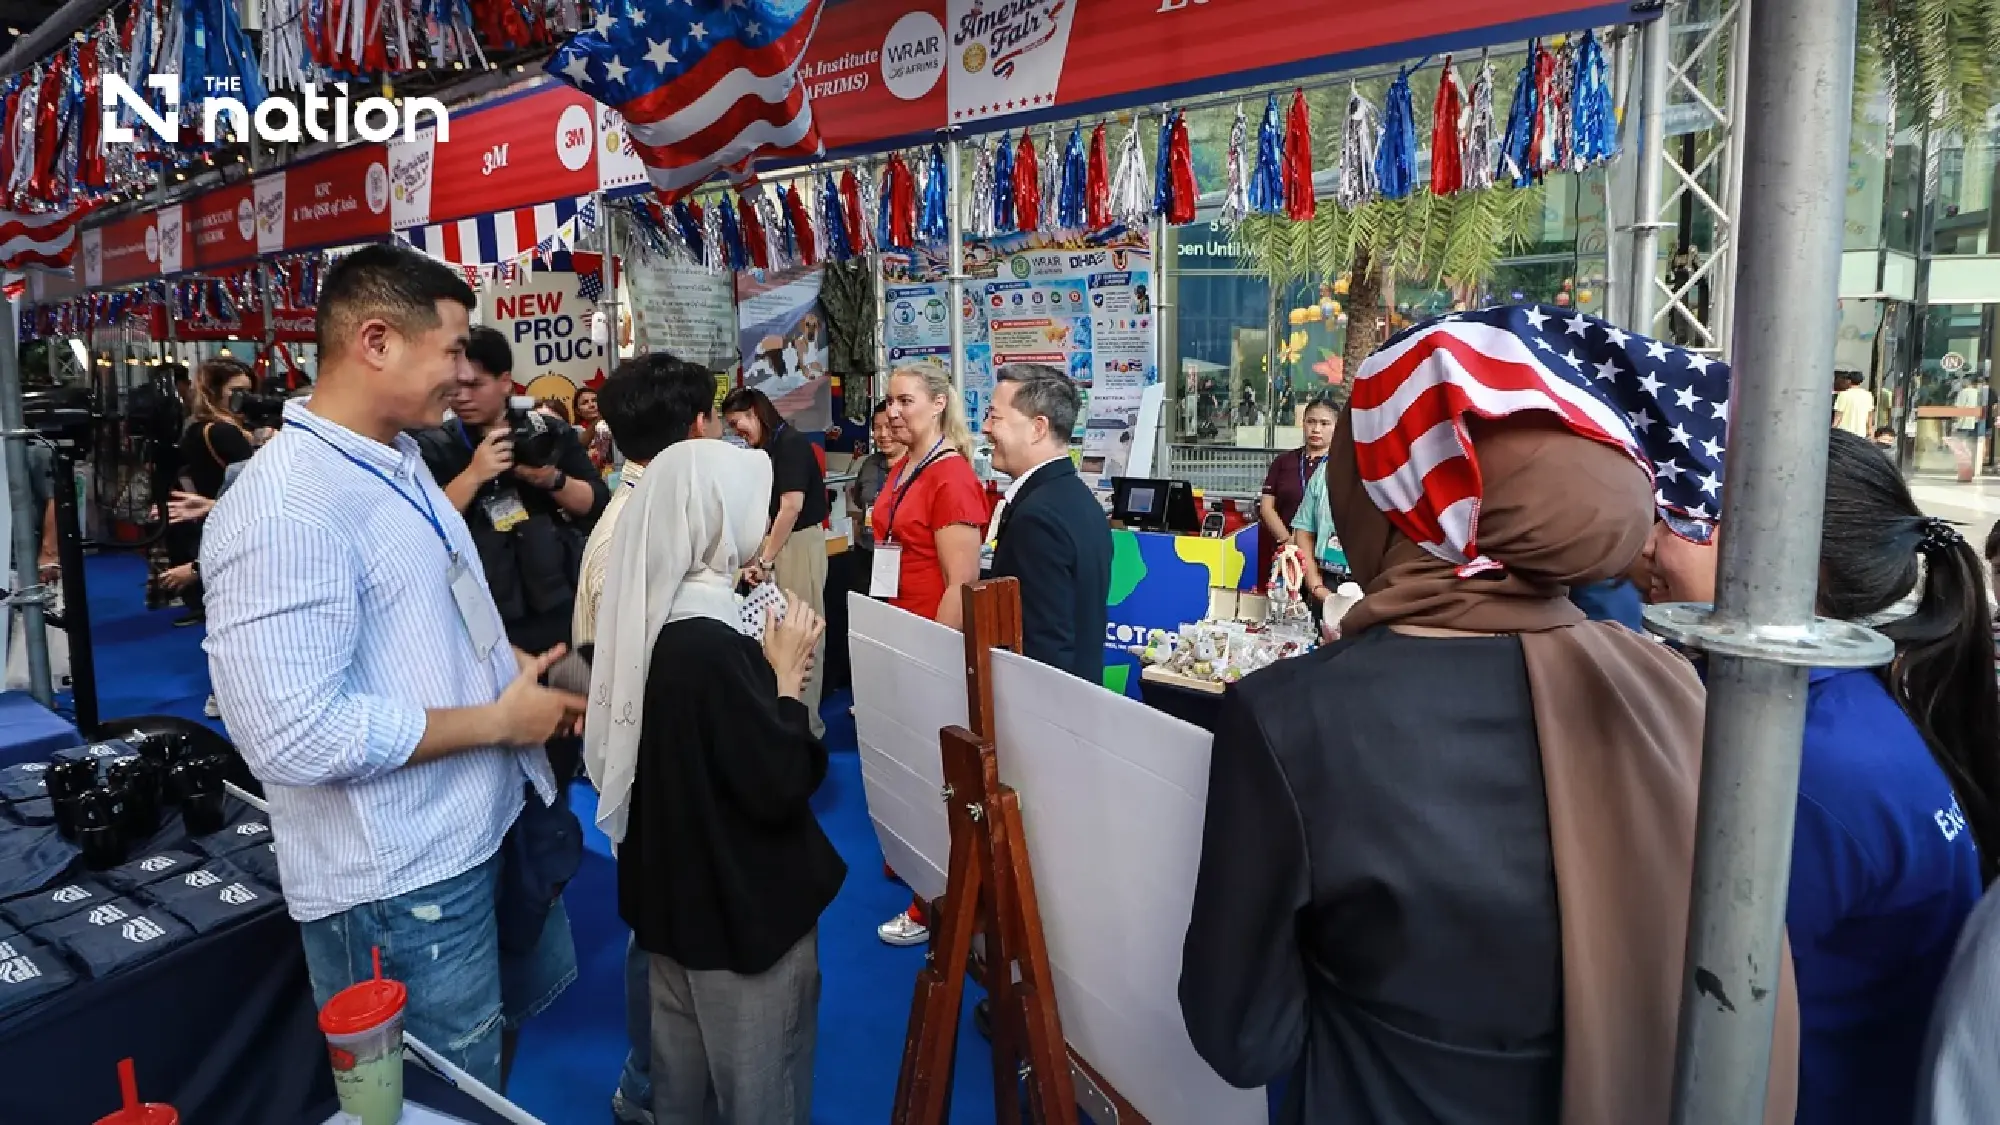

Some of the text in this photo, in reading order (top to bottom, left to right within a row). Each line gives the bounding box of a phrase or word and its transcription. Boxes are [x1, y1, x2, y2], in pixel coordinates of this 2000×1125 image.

[990, 11, 1041, 58] Fair
[816, 50, 879, 76] Institute
[887, 36, 939, 64] WRAIR
[564, 127, 586, 149] 3M
[482, 142, 509, 176] 3M
[1206, 241, 1240, 256] Until
[496, 291, 563, 320] NEW
[514, 314, 574, 343] PRO
